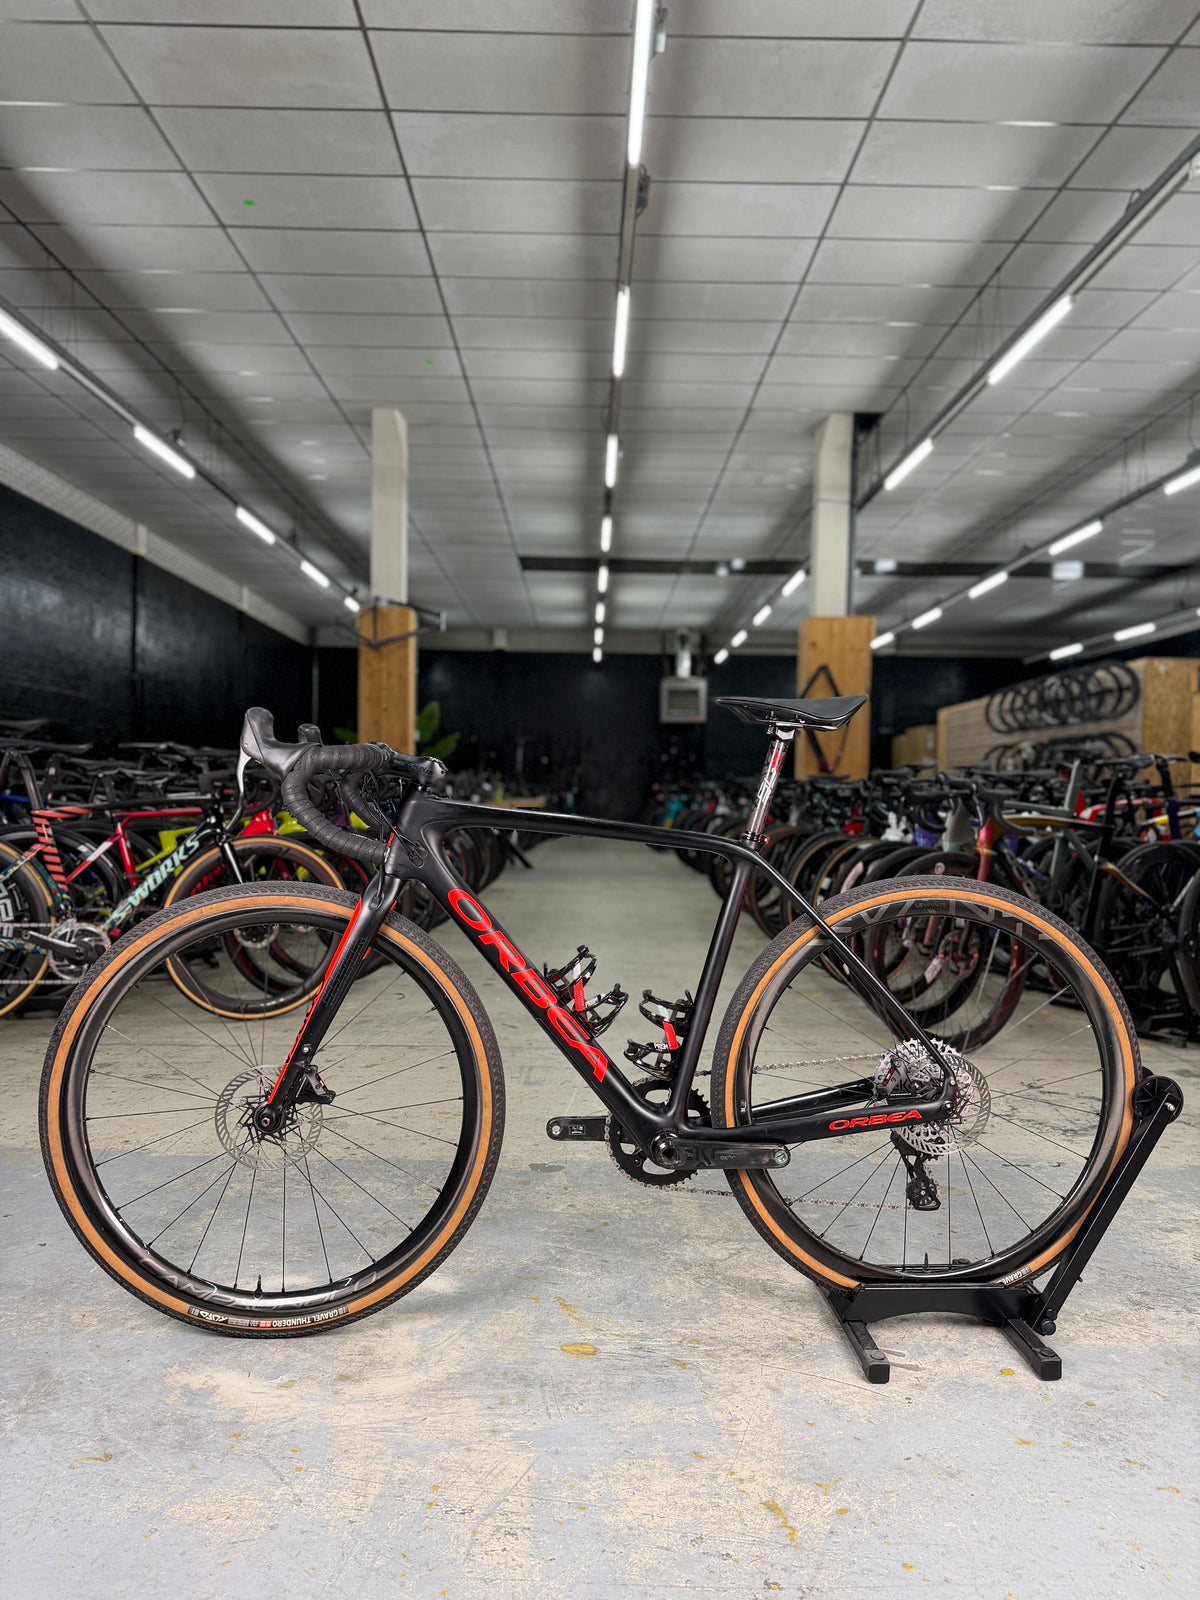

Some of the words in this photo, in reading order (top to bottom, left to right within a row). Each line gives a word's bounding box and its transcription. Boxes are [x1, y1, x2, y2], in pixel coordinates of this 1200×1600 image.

[110, 833, 200, 926] S-WORKS
[447, 888, 608, 1083] ORBEA
[828, 1109, 923, 1131] ORBEA
[272, 1316, 312, 1328] THUNDERO
[311, 1308, 339, 1324] GRAVEL
